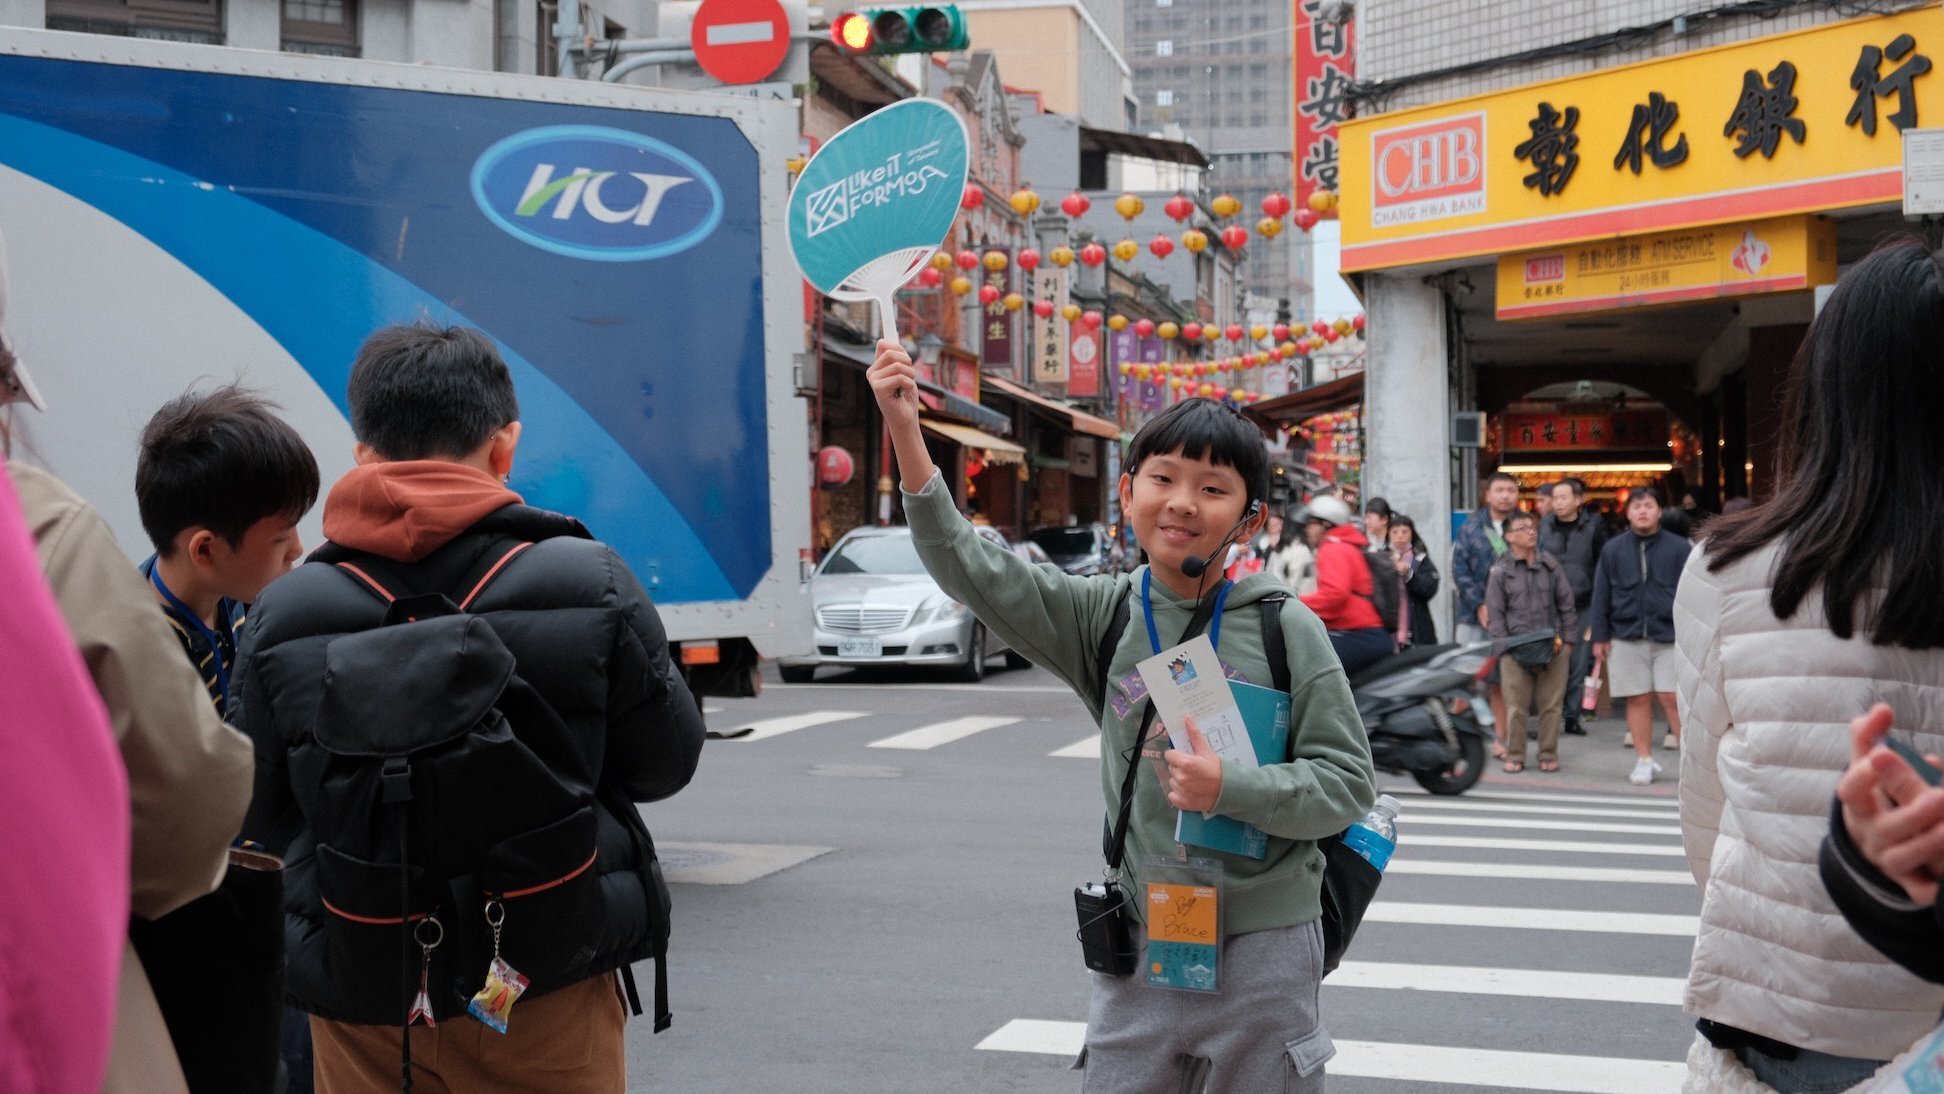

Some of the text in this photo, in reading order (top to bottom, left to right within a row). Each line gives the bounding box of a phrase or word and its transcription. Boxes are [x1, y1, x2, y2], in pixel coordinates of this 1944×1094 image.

[1302, 1, 1350, 190] 百安堂
[1514, 33, 1932, 197] 彰化銀行
[515, 164, 694, 226] HCT
[850, 165, 949, 219] FORMOSA
[1377, 127, 1480, 197] CHB
[1374, 196, 1485, 225] CHANG HWA BANK
